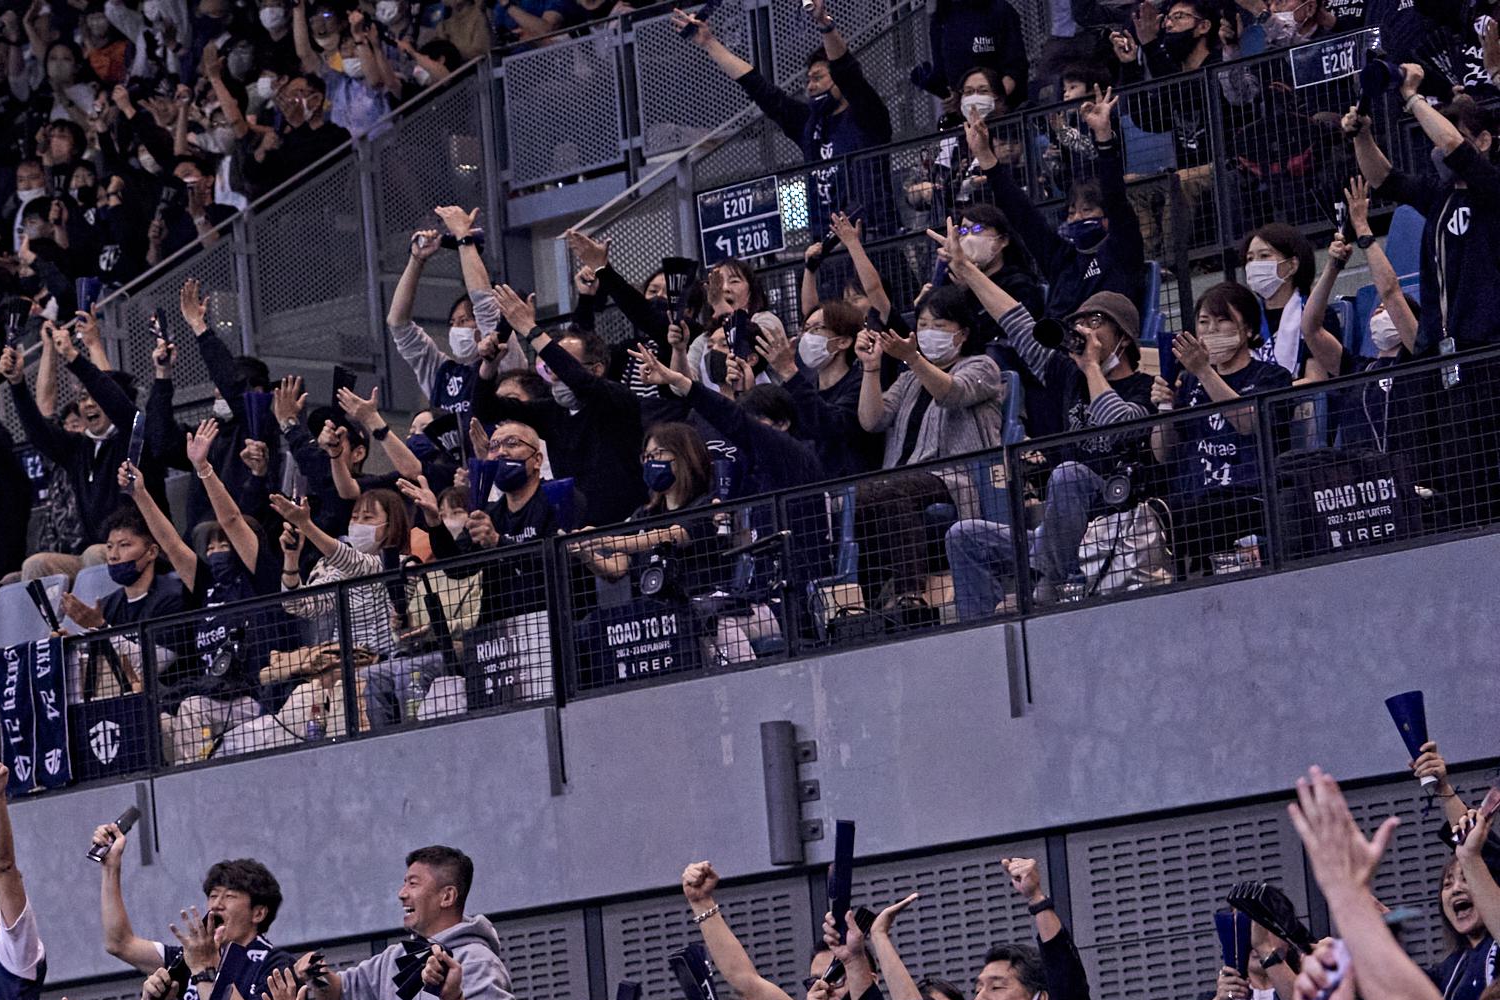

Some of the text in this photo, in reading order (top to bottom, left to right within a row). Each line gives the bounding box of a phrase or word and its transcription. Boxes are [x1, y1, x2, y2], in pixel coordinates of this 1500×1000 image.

[723, 195, 753, 219] E207
[736, 229, 770, 254] E208
[1313, 477, 1397, 513] ROAD TO B1
[606, 613, 677, 646] ROAD TO B1
[476, 636, 509, 663] ROAD
